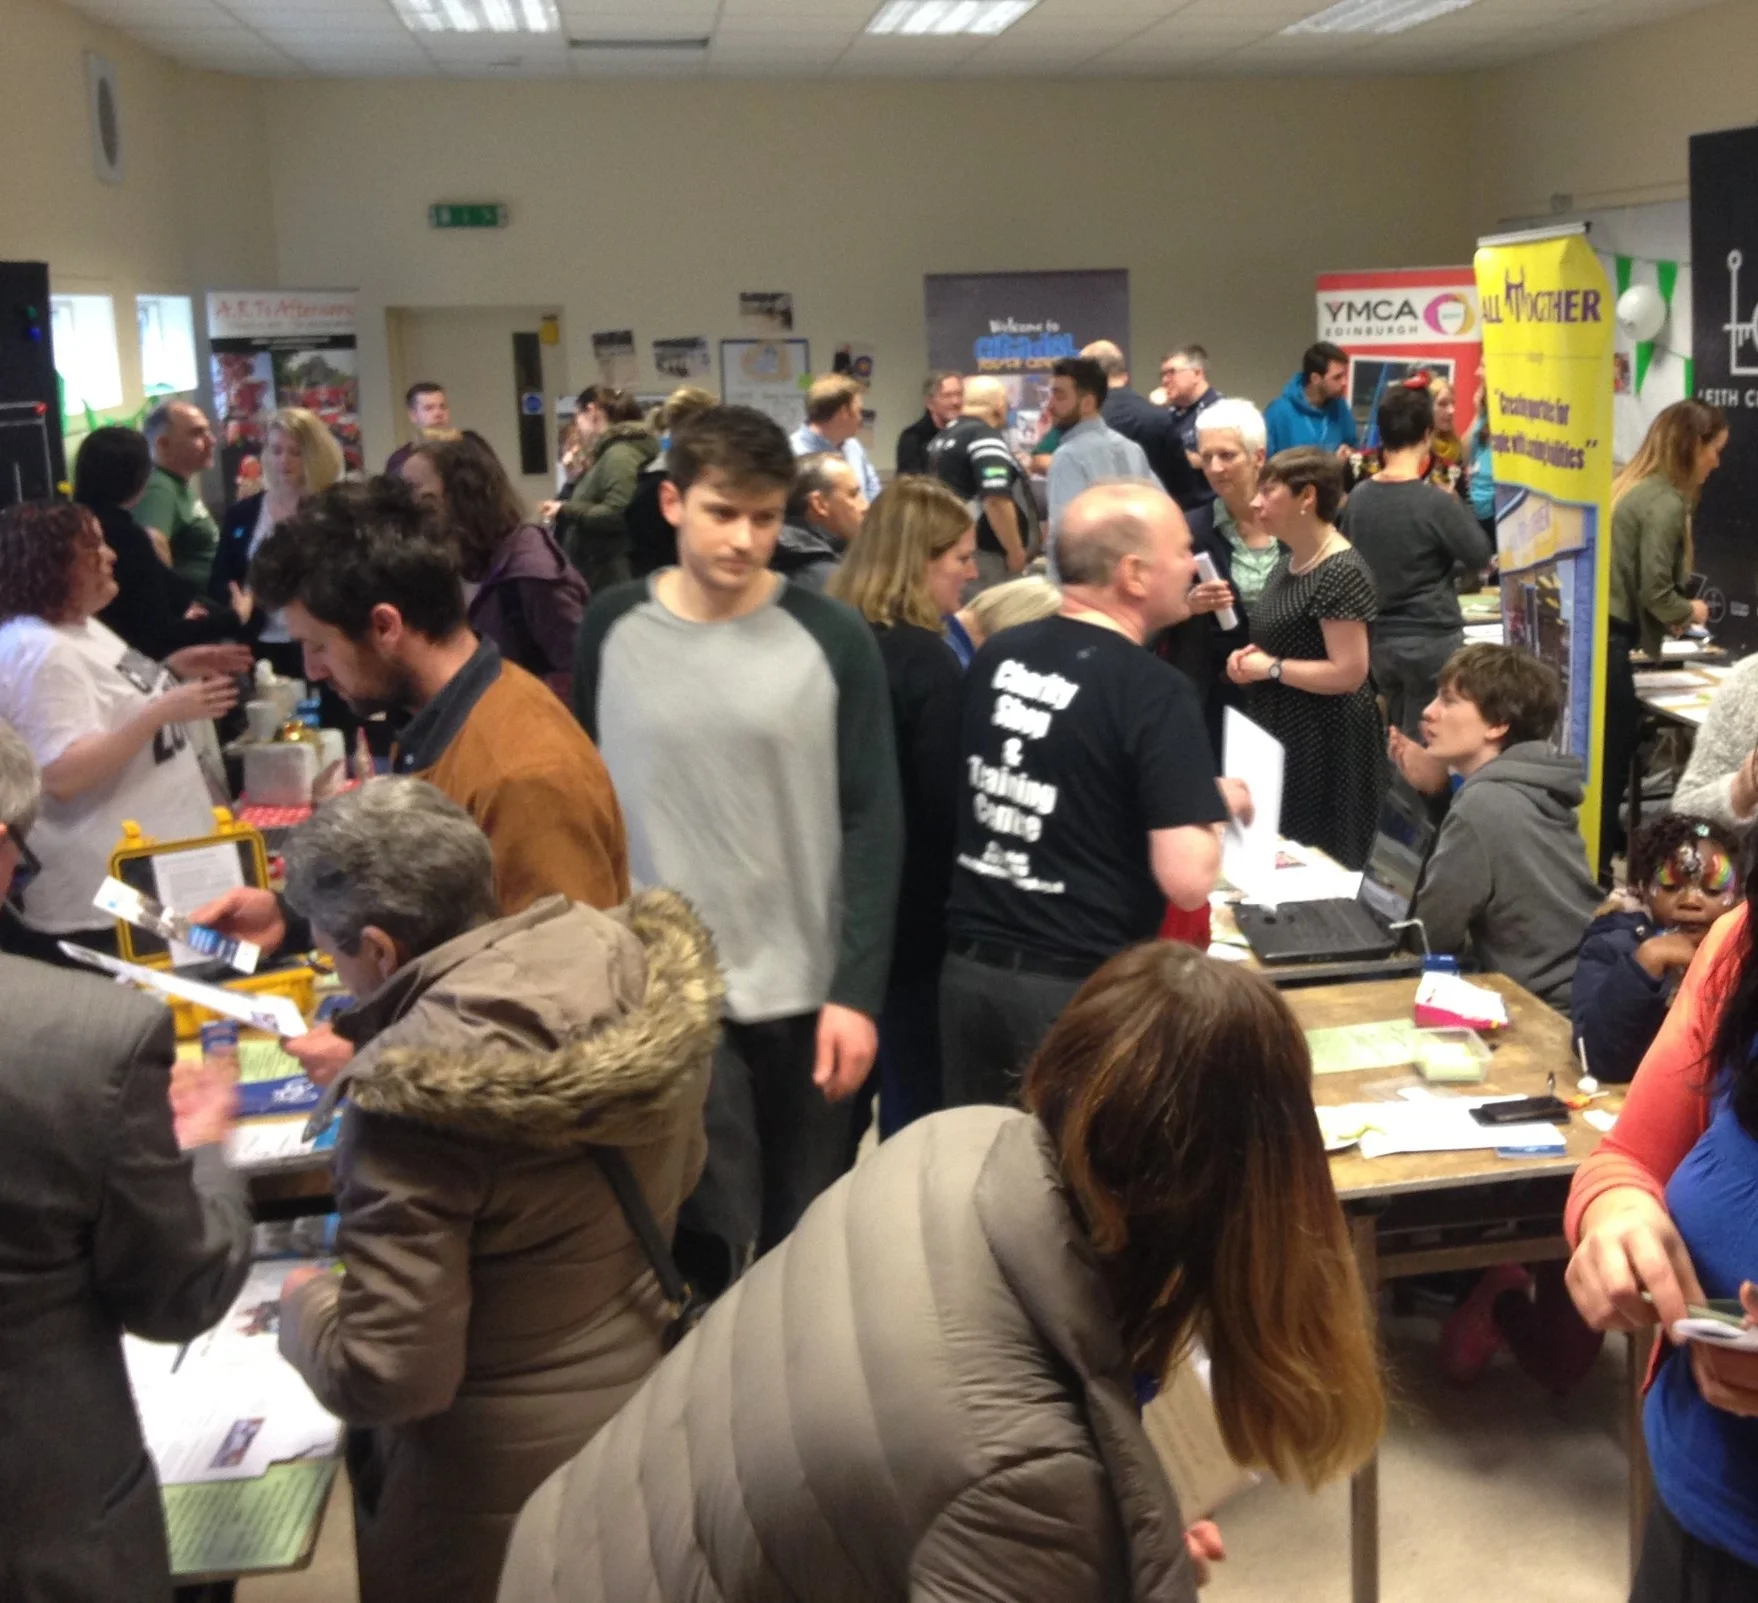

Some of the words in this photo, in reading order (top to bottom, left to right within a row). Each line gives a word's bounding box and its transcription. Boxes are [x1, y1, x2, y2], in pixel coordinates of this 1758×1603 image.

[1325, 299, 1419, 323] YMCA
[989, 317, 1042, 334] Welcome
[1046, 319, 1060, 333] to
[1326, 325, 1419, 338] EDINBURGH
[991, 659, 1080, 711] Charity
[967, 754, 1058, 815] Training
